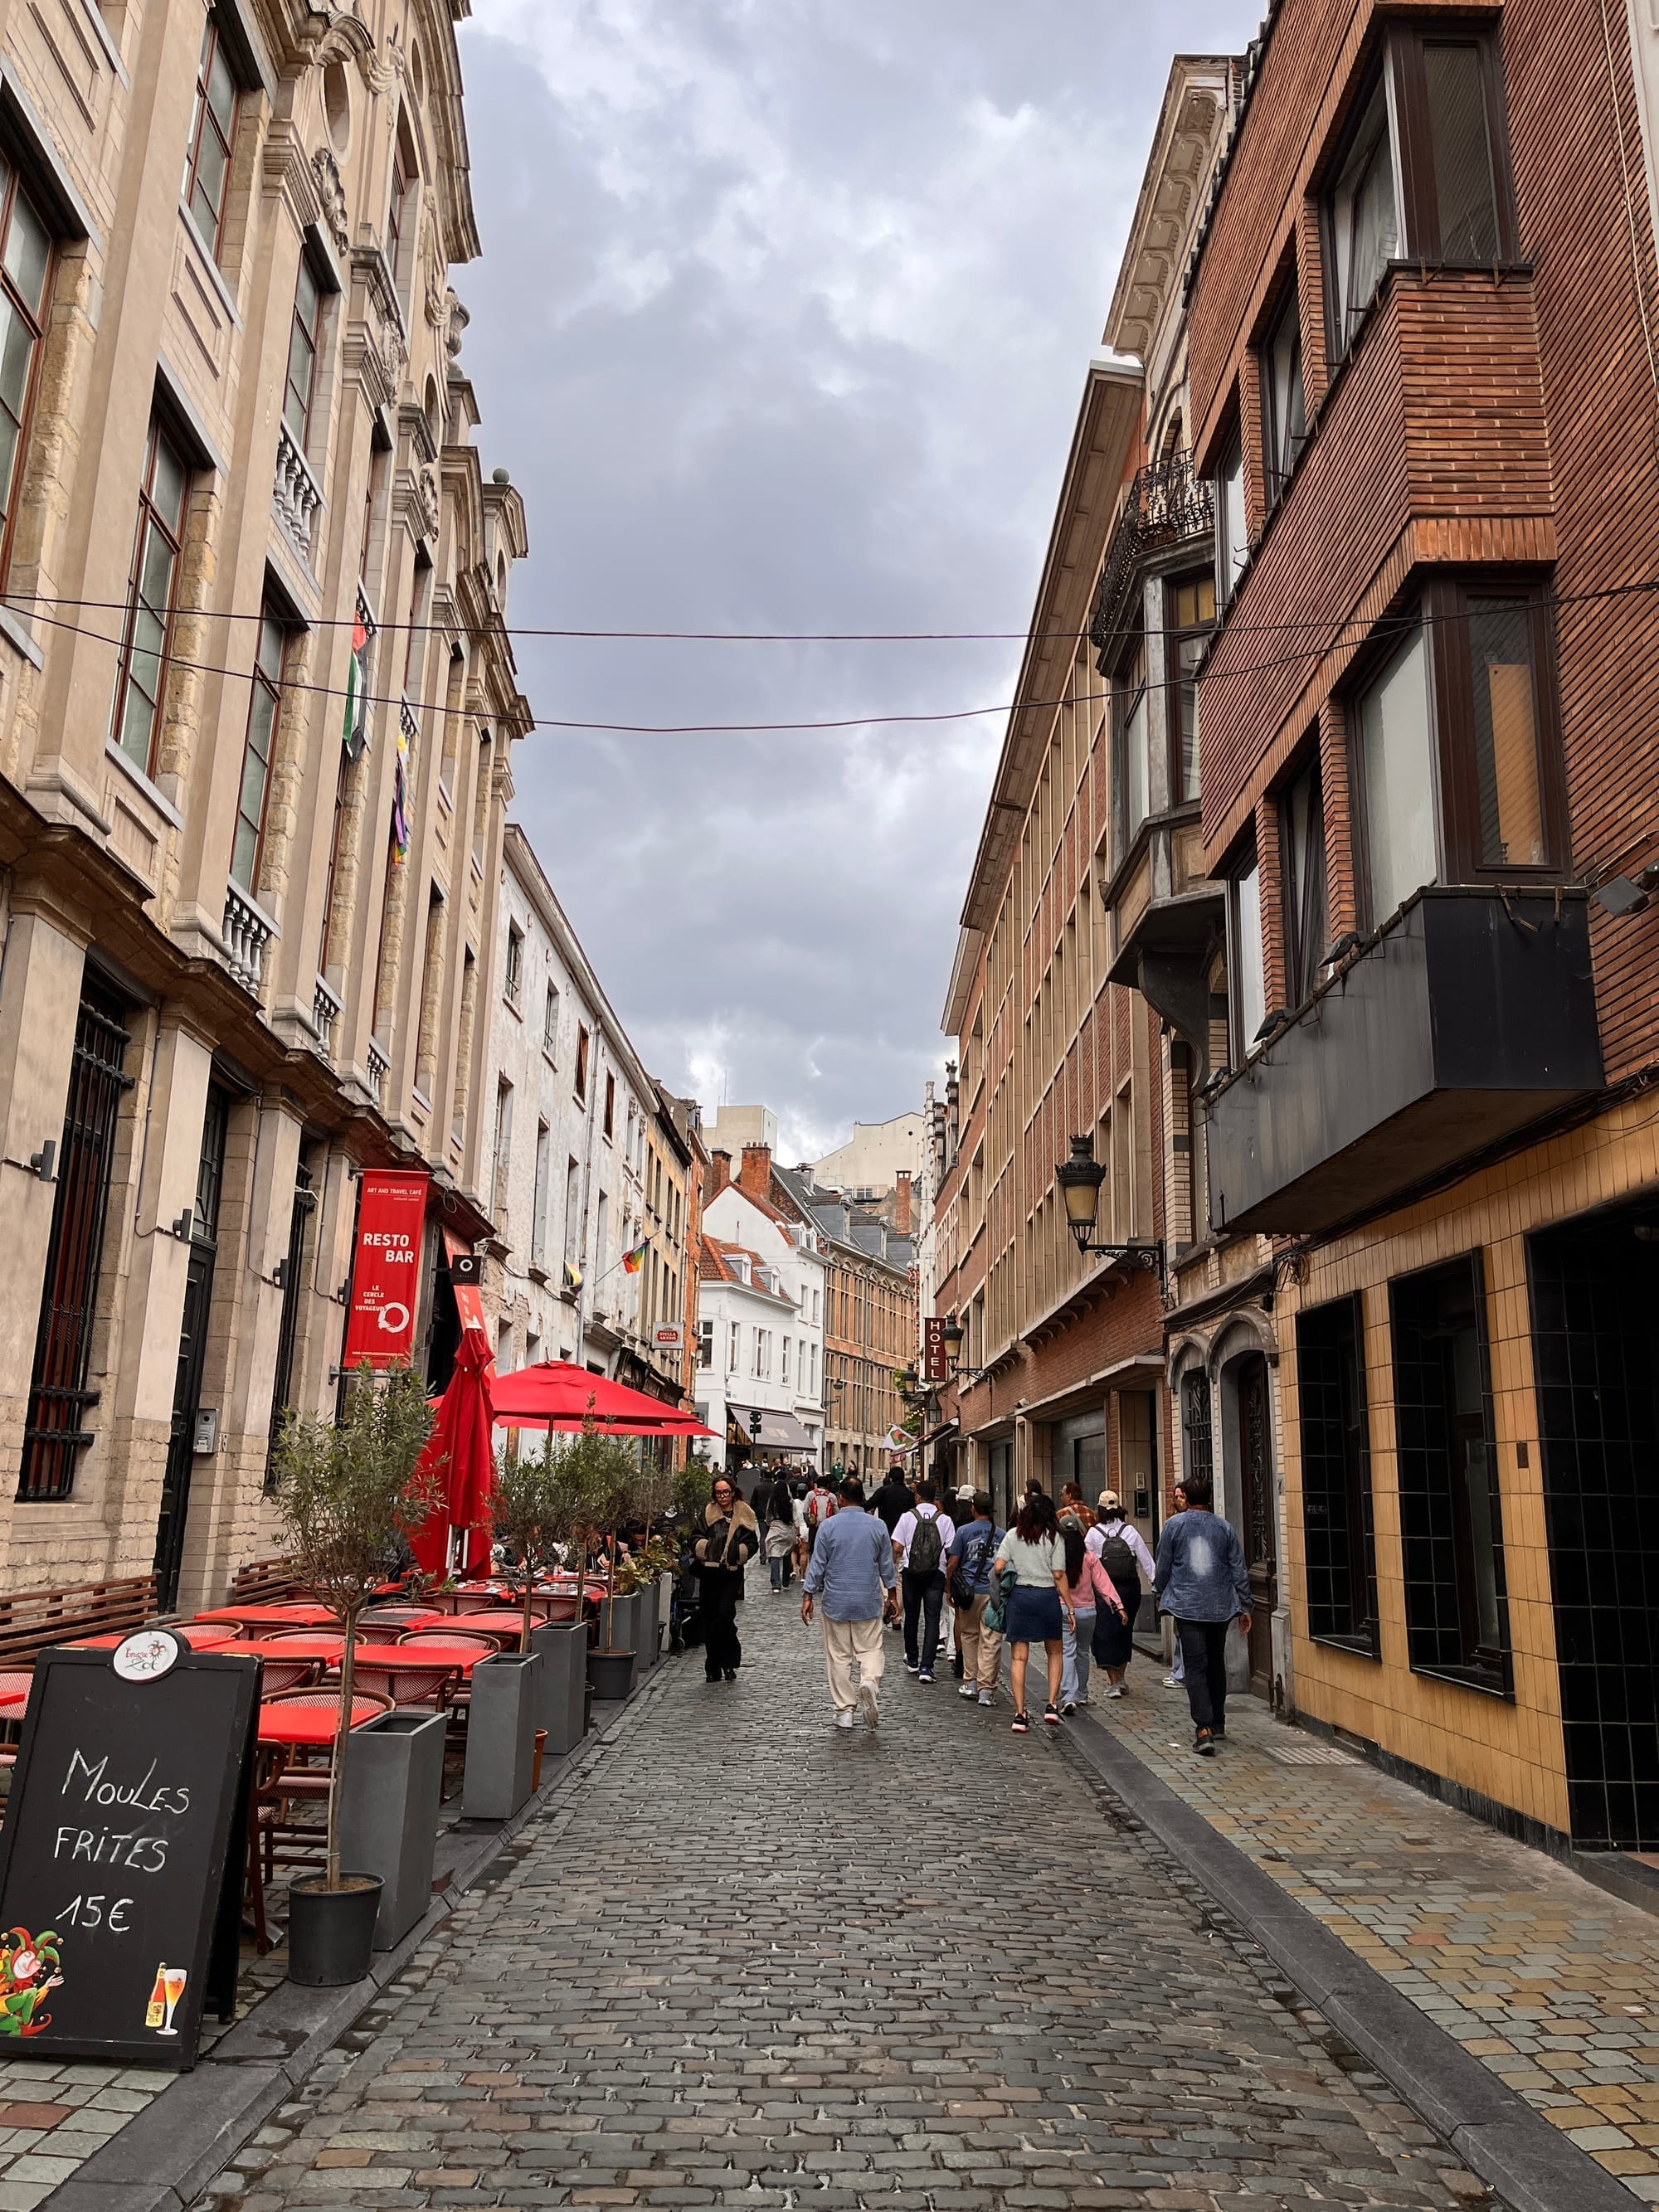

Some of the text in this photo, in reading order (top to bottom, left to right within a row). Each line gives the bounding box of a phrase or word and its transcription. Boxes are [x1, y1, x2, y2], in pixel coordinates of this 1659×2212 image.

[362, 1232, 410, 1247] RESTO
[385, 1249, 414, 1263] BAR
[929, 1321, 941, 1378] HOTEL
[55, 1894, 134, 1932] 15€
